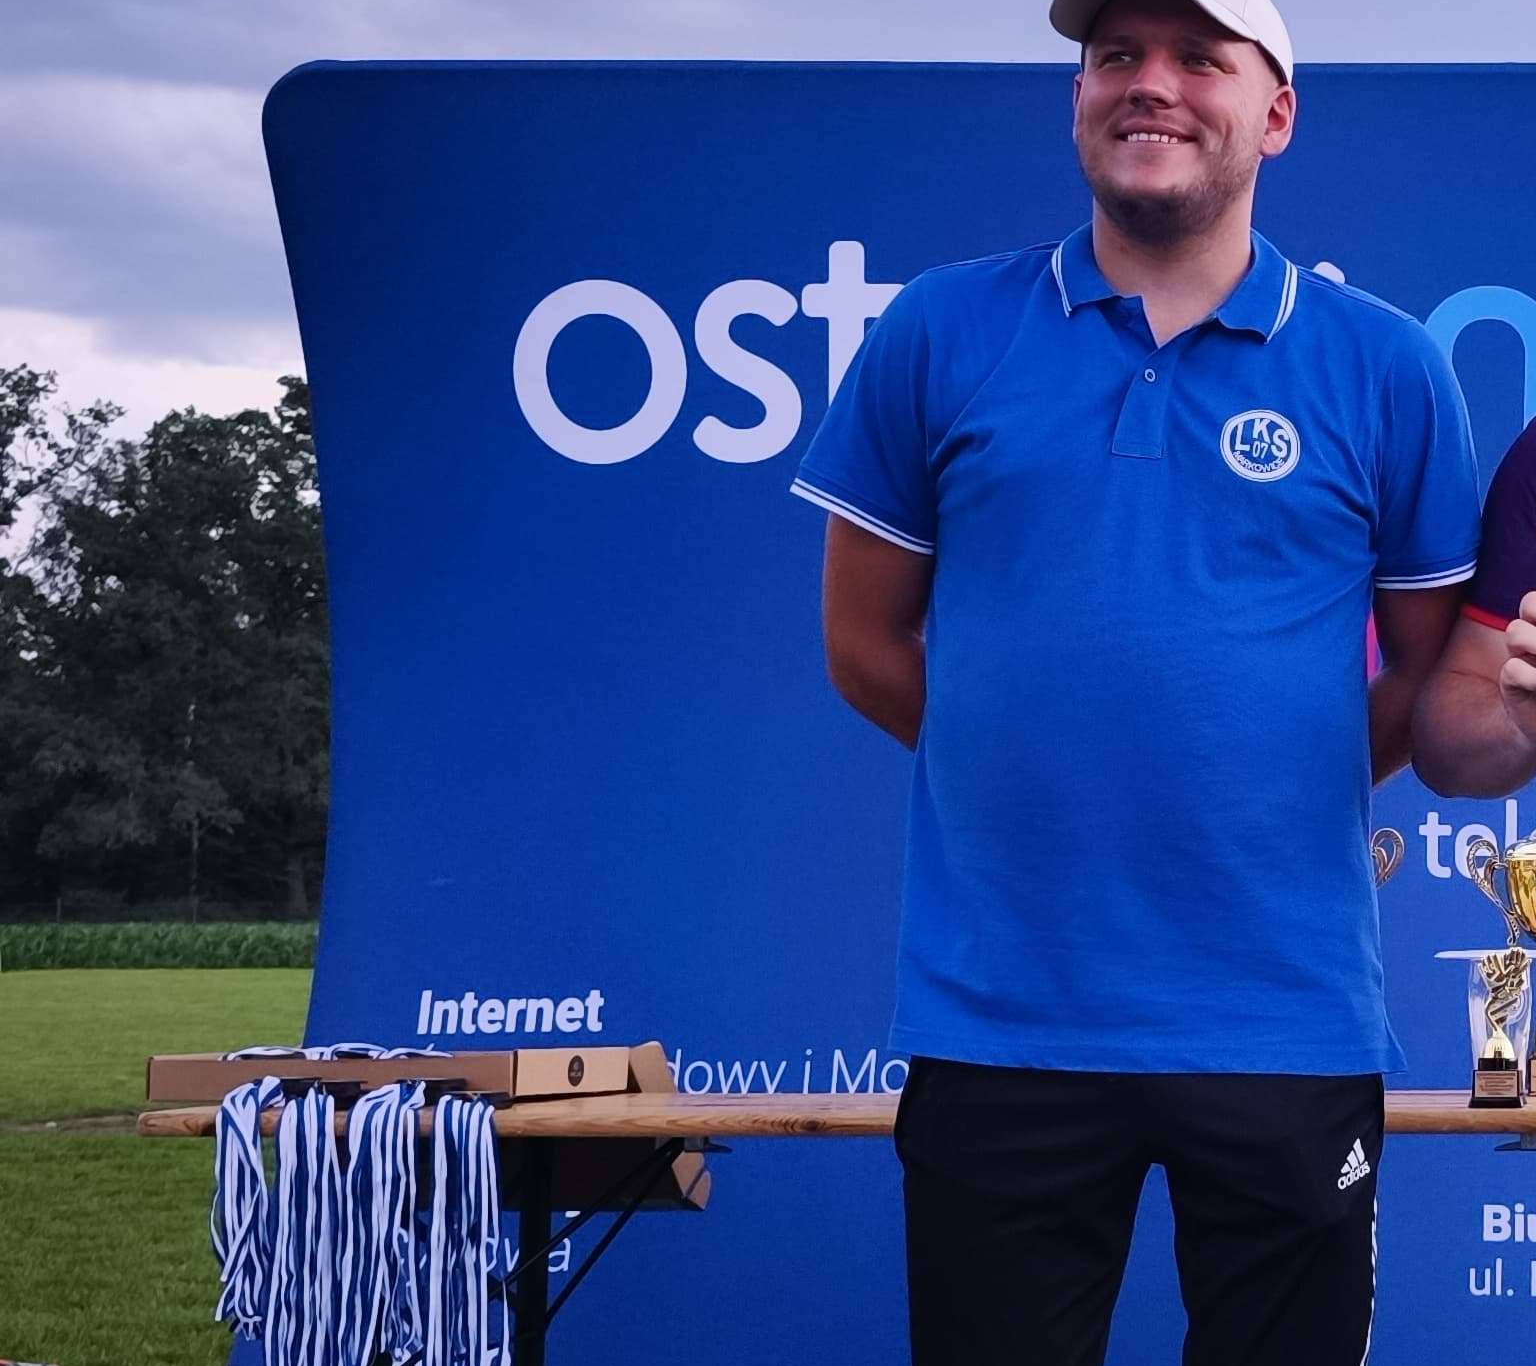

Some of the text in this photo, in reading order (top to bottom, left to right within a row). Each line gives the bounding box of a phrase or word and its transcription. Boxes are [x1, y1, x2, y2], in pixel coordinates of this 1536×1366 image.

[513, 240, 905, 464] ost
[1234, 418, 1290, 458] LKS
[1252, 440, 1269, 459] 07
[417, 989, 604, 1035] Internet
[830, 1048, 911, 1095] Mo
[1469, 1257, 1514, 1296] ul.
